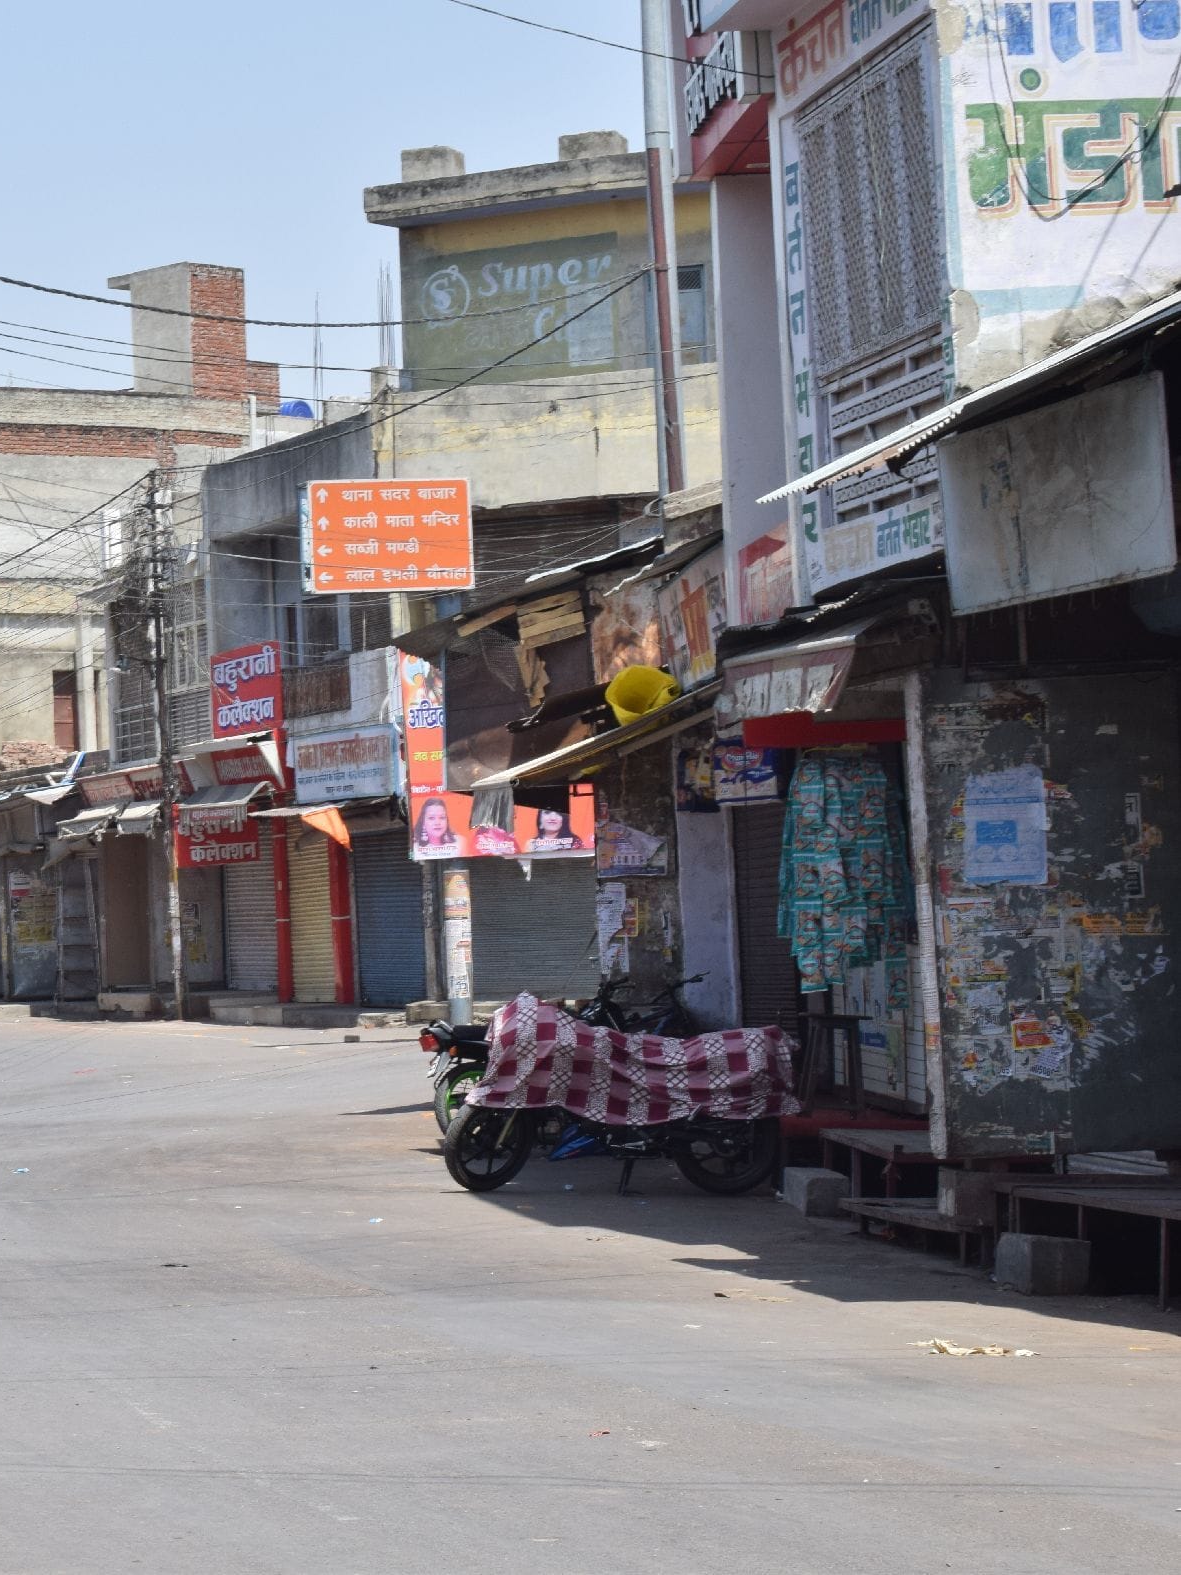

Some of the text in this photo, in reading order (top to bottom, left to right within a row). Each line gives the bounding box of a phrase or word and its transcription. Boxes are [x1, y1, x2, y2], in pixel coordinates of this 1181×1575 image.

[965, 67, 1181, 213] भंडा
[478, 254, 612, 304] Super
[342, 489, 373, 502] थाना
[379, 488, 410, 501] सदर
[343, 511, 378, 529] काली
[385, 515, 415, 528] माता
[346, 568, 375, 582] लाल
